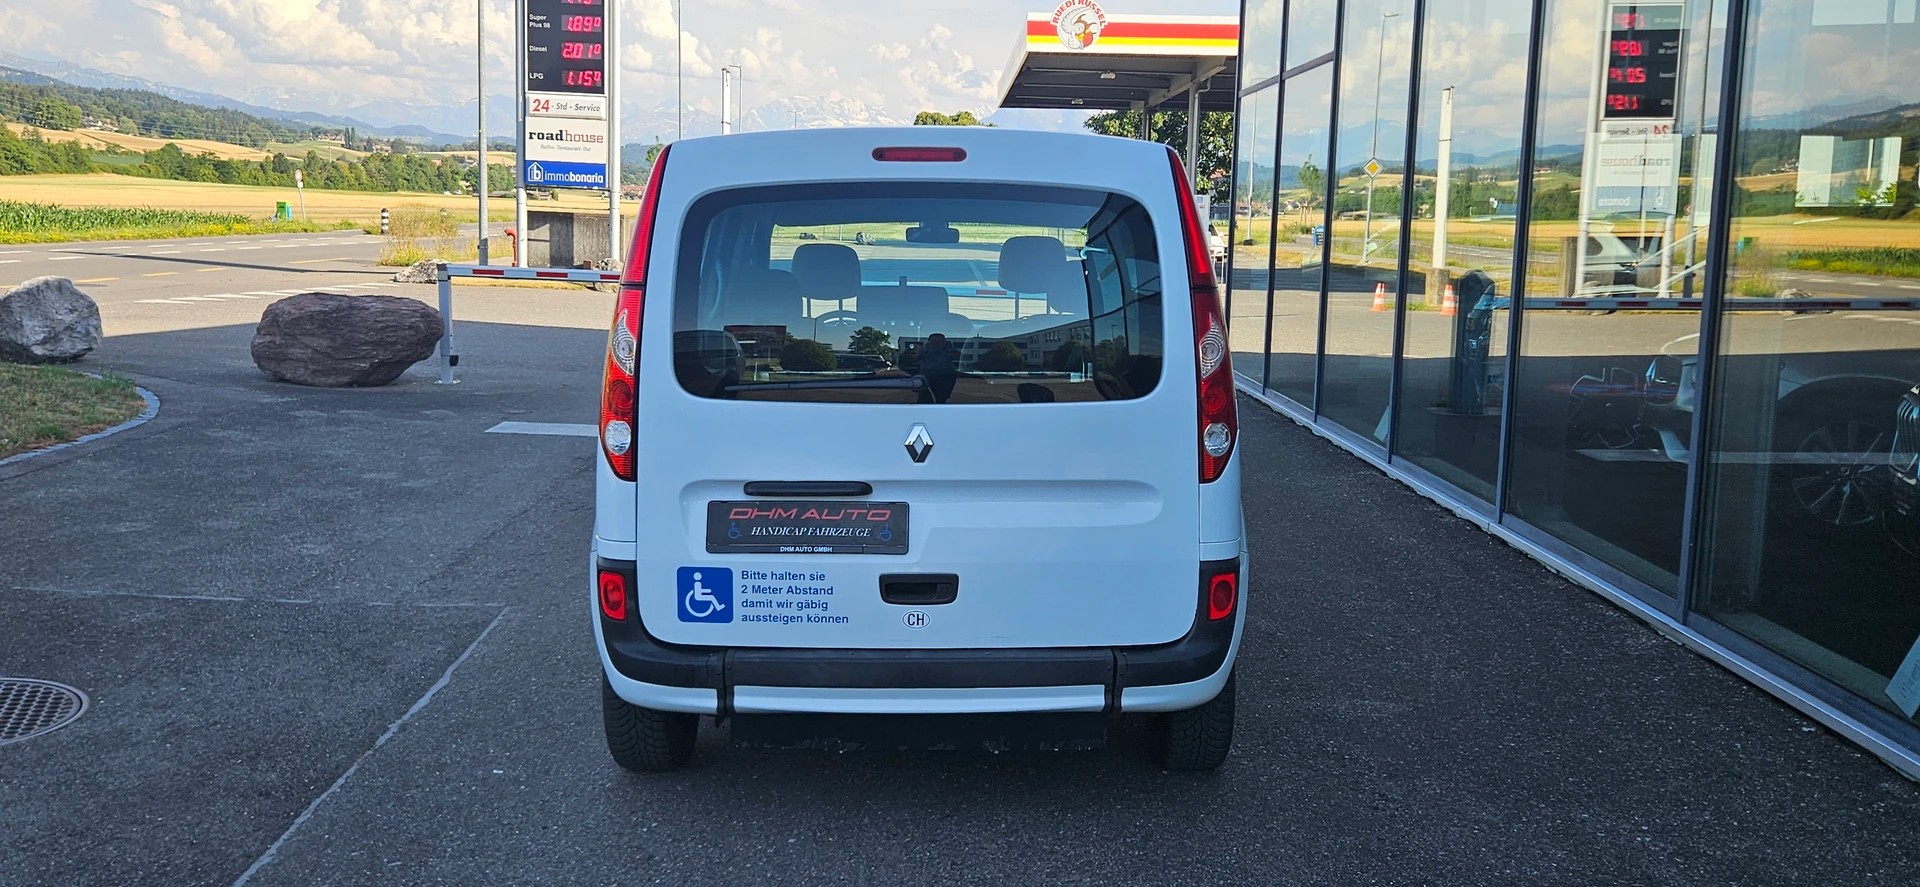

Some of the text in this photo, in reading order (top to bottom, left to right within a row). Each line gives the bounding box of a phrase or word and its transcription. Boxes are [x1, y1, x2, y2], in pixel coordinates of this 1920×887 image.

[1052, 0, 1076, 24] RUEDI
[532, 98, 550, 112] 24
[556, 102, 568, 110] Std
[574, 103, 601, 112] Service
[528, 129, 604, 143] roadhouse
[544, 170, 604, 184] immobonaria
[729, 508, 891, 521] DHM AUTO
[751, 526, 872, 537] HANDICAP FAHRZEUGE
[741, 570, 826, 581] Bitte halten sie
[741, 585, 834, 595] 2 Meter Abstand
[741, 599, 829, 612] damit wir gäbig
[741, 613, 849, 625] aussteigen können
[907, 613, 925, 626] CH
